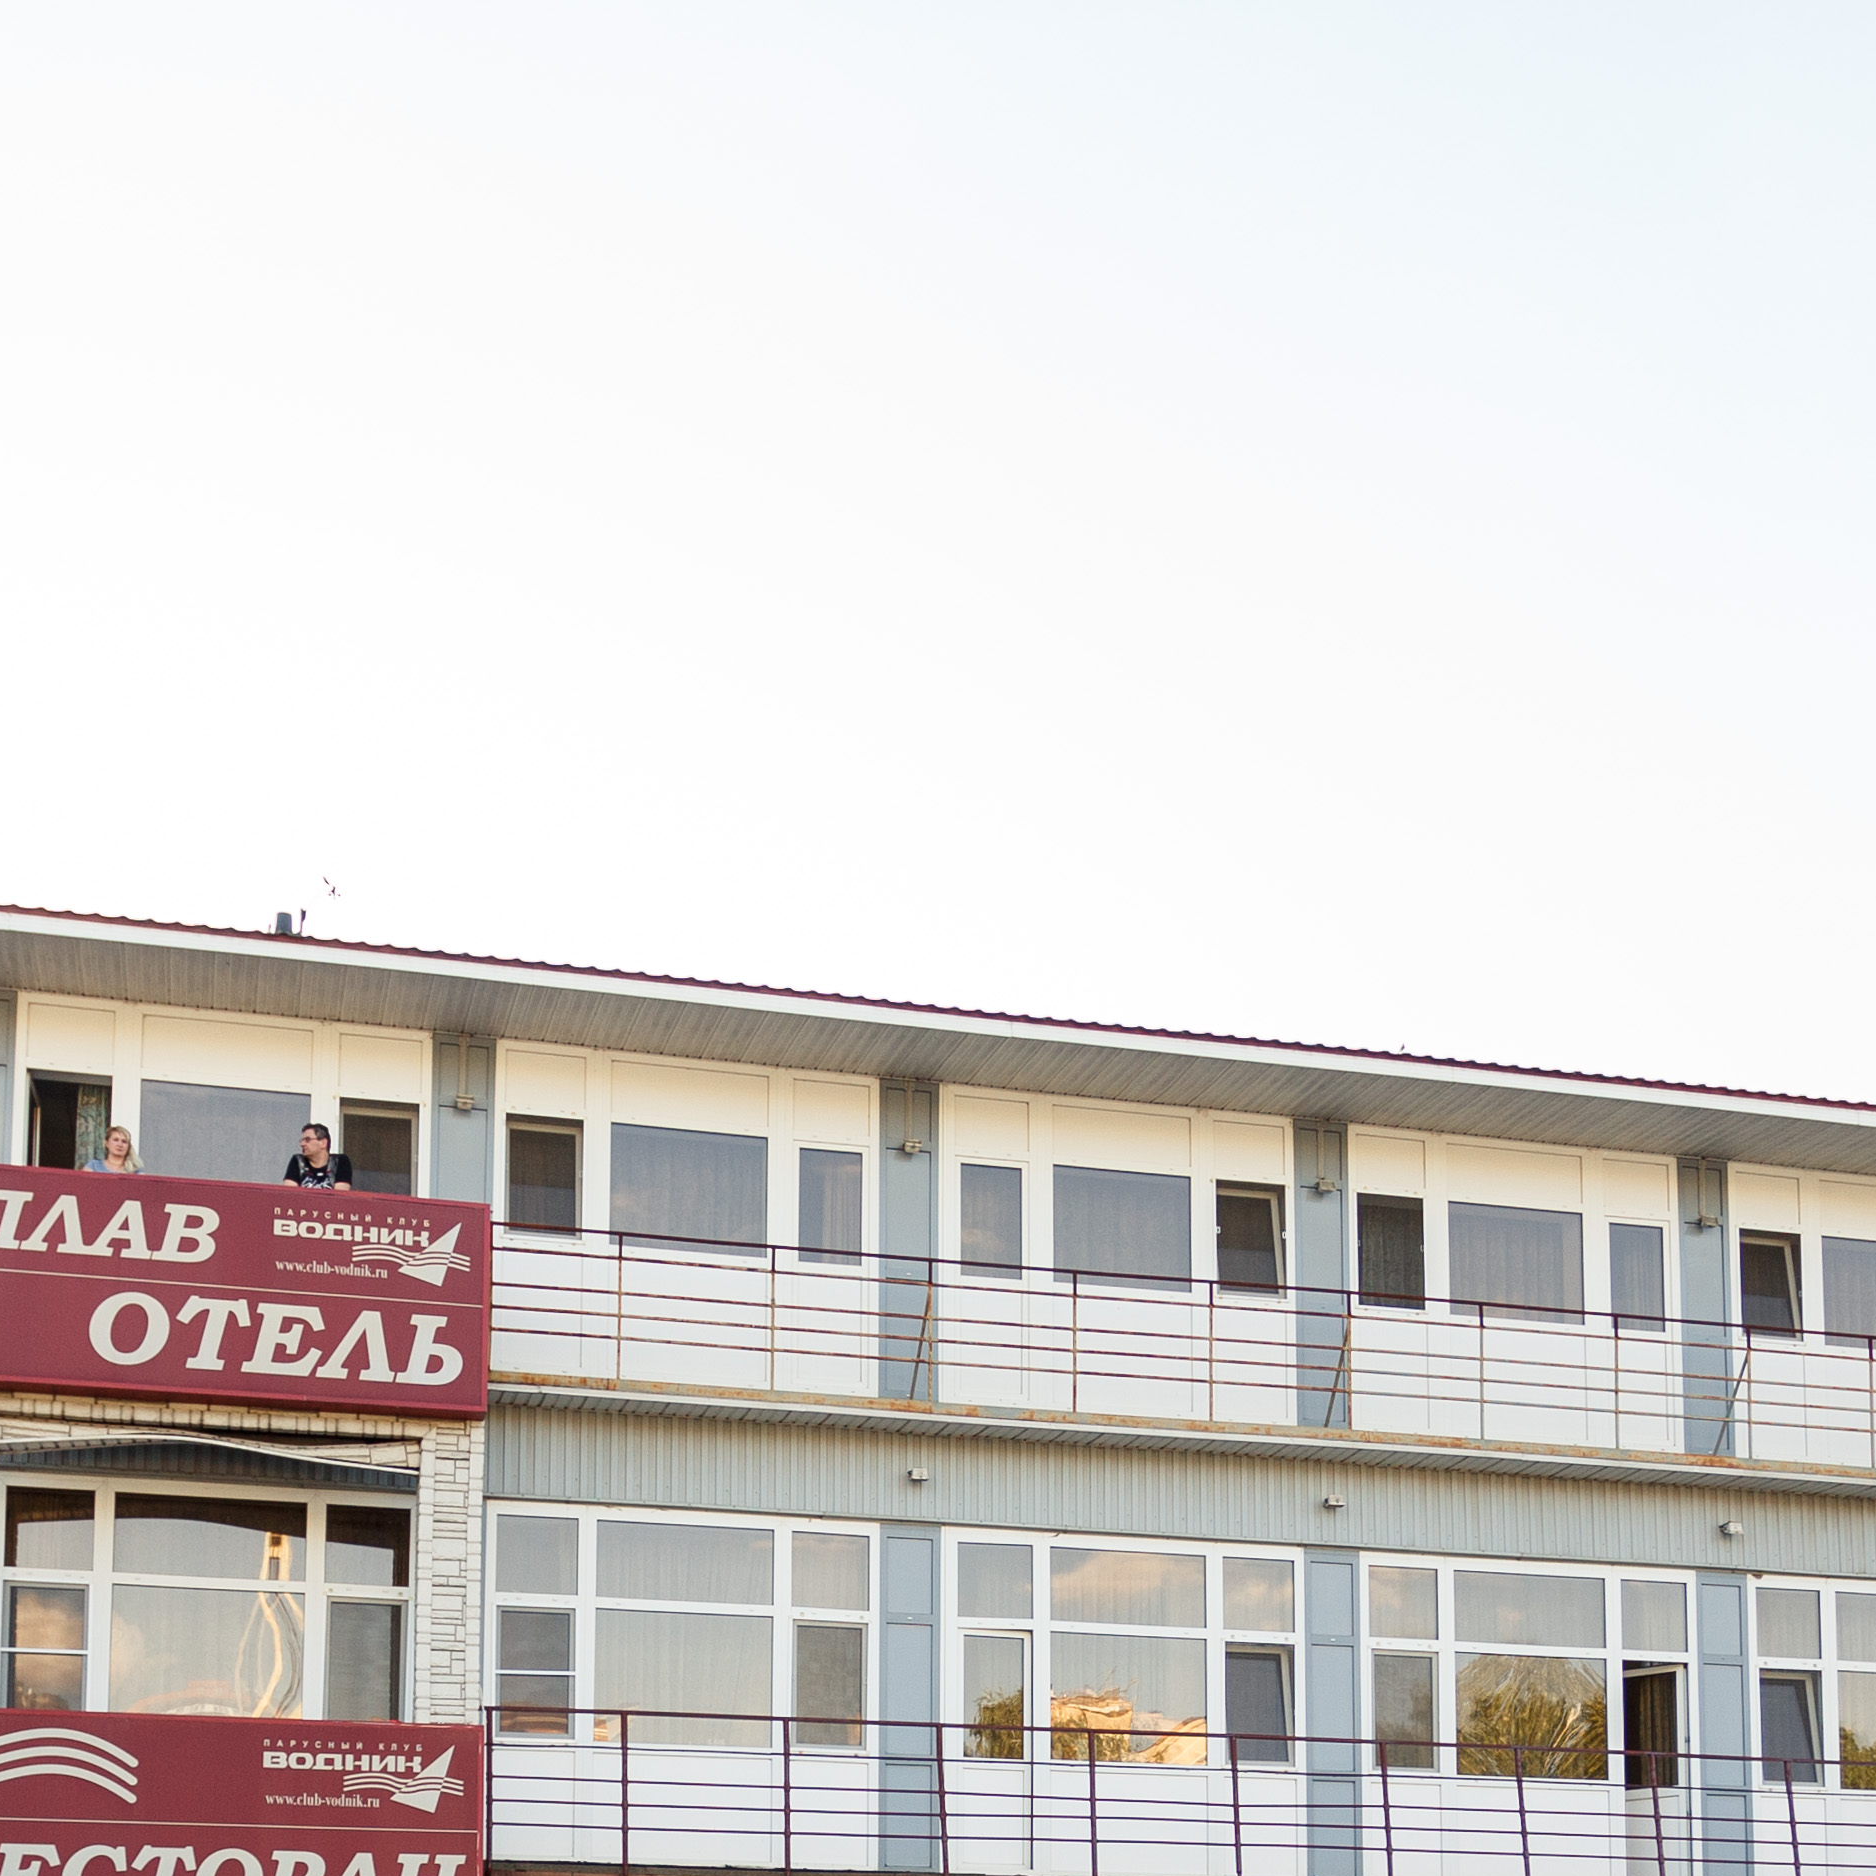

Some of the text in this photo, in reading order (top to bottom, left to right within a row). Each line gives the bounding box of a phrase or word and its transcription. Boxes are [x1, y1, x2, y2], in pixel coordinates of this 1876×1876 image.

[274, 1207, 430, 1228] ПАРУСНЫЙ КЛУБ
[273, 1218, 430, 1248] ВОДНИК
[275, 1260, 389, 1279] www.club-vodnik.ru
[89, 1291, 464, 1386] ОТЕЛЬ
[263, 1738, 423, 1752] ПАРУСНЫЙ КЛУБ
[262, 1751, 423, 1773] ВОДНИК
[264, 1793, 380, 1808] www.club-vodnik.ru
